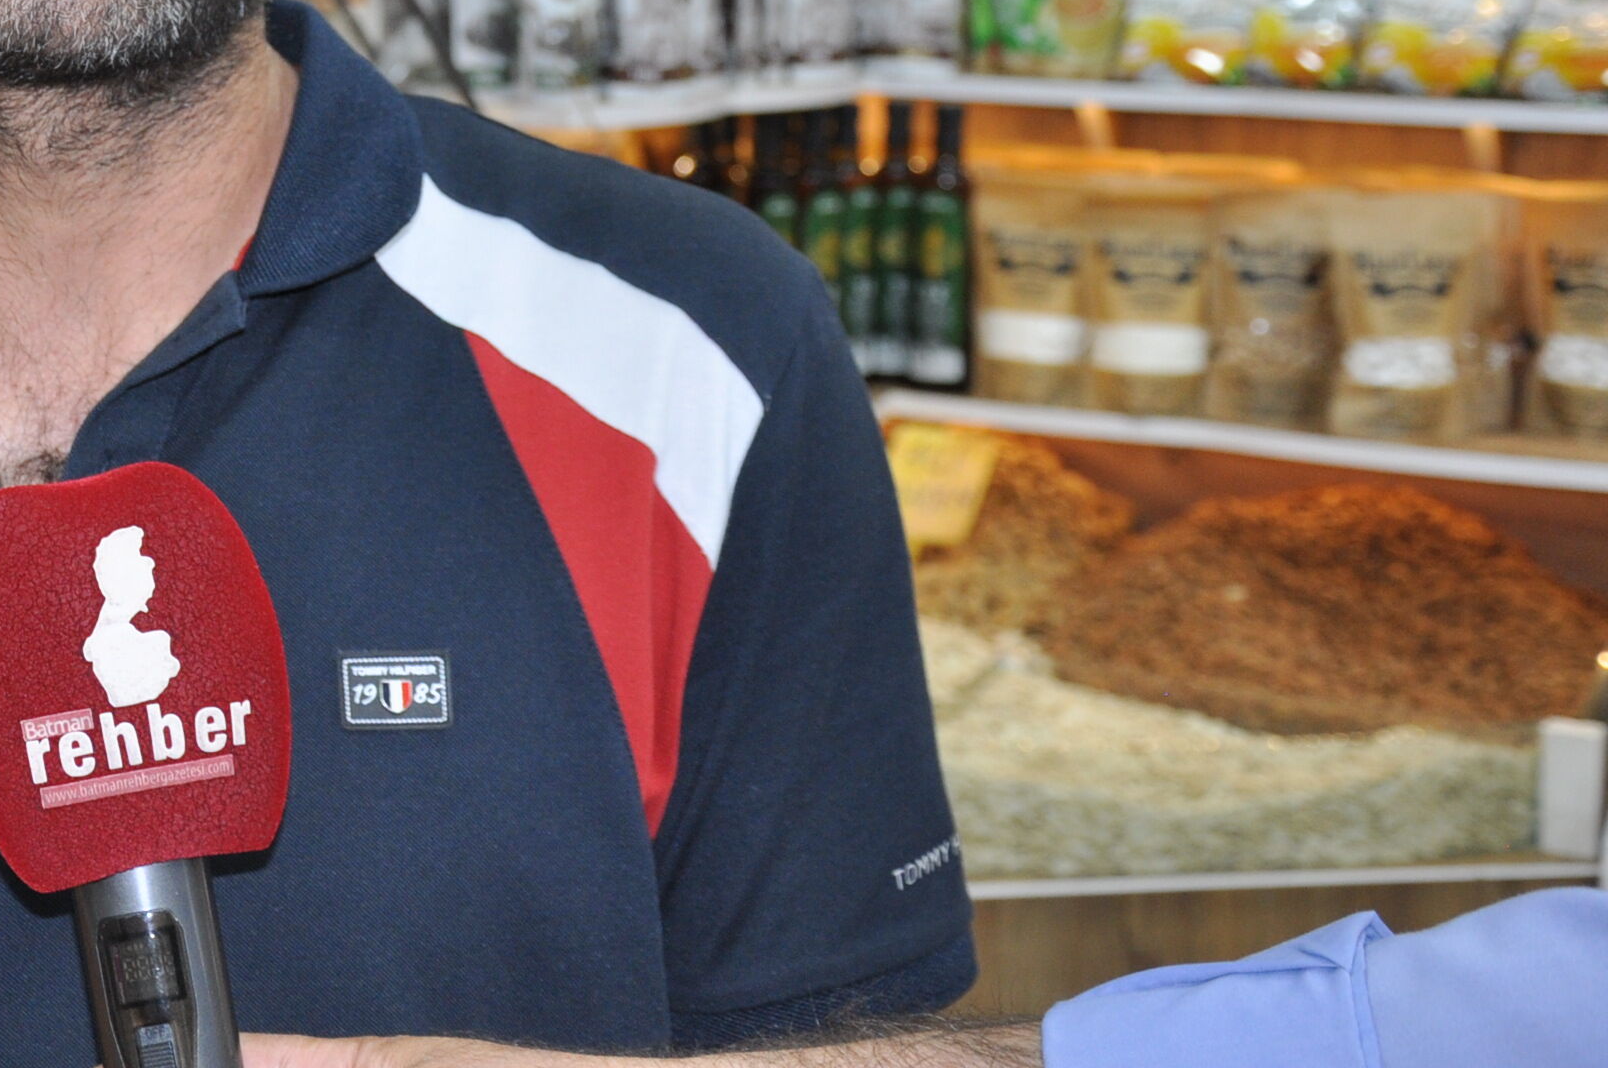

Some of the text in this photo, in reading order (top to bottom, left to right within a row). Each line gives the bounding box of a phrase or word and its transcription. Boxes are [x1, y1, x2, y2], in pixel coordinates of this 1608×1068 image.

[352, 682, 445, 705] 19 85
[24, 714, 92, 740] Batman
[26, 699, 251, 785] rehber
[44, 760, 230, 804] www.batmanrehbergazetesi.com
[892, 841, 950, 892] TOMMY
